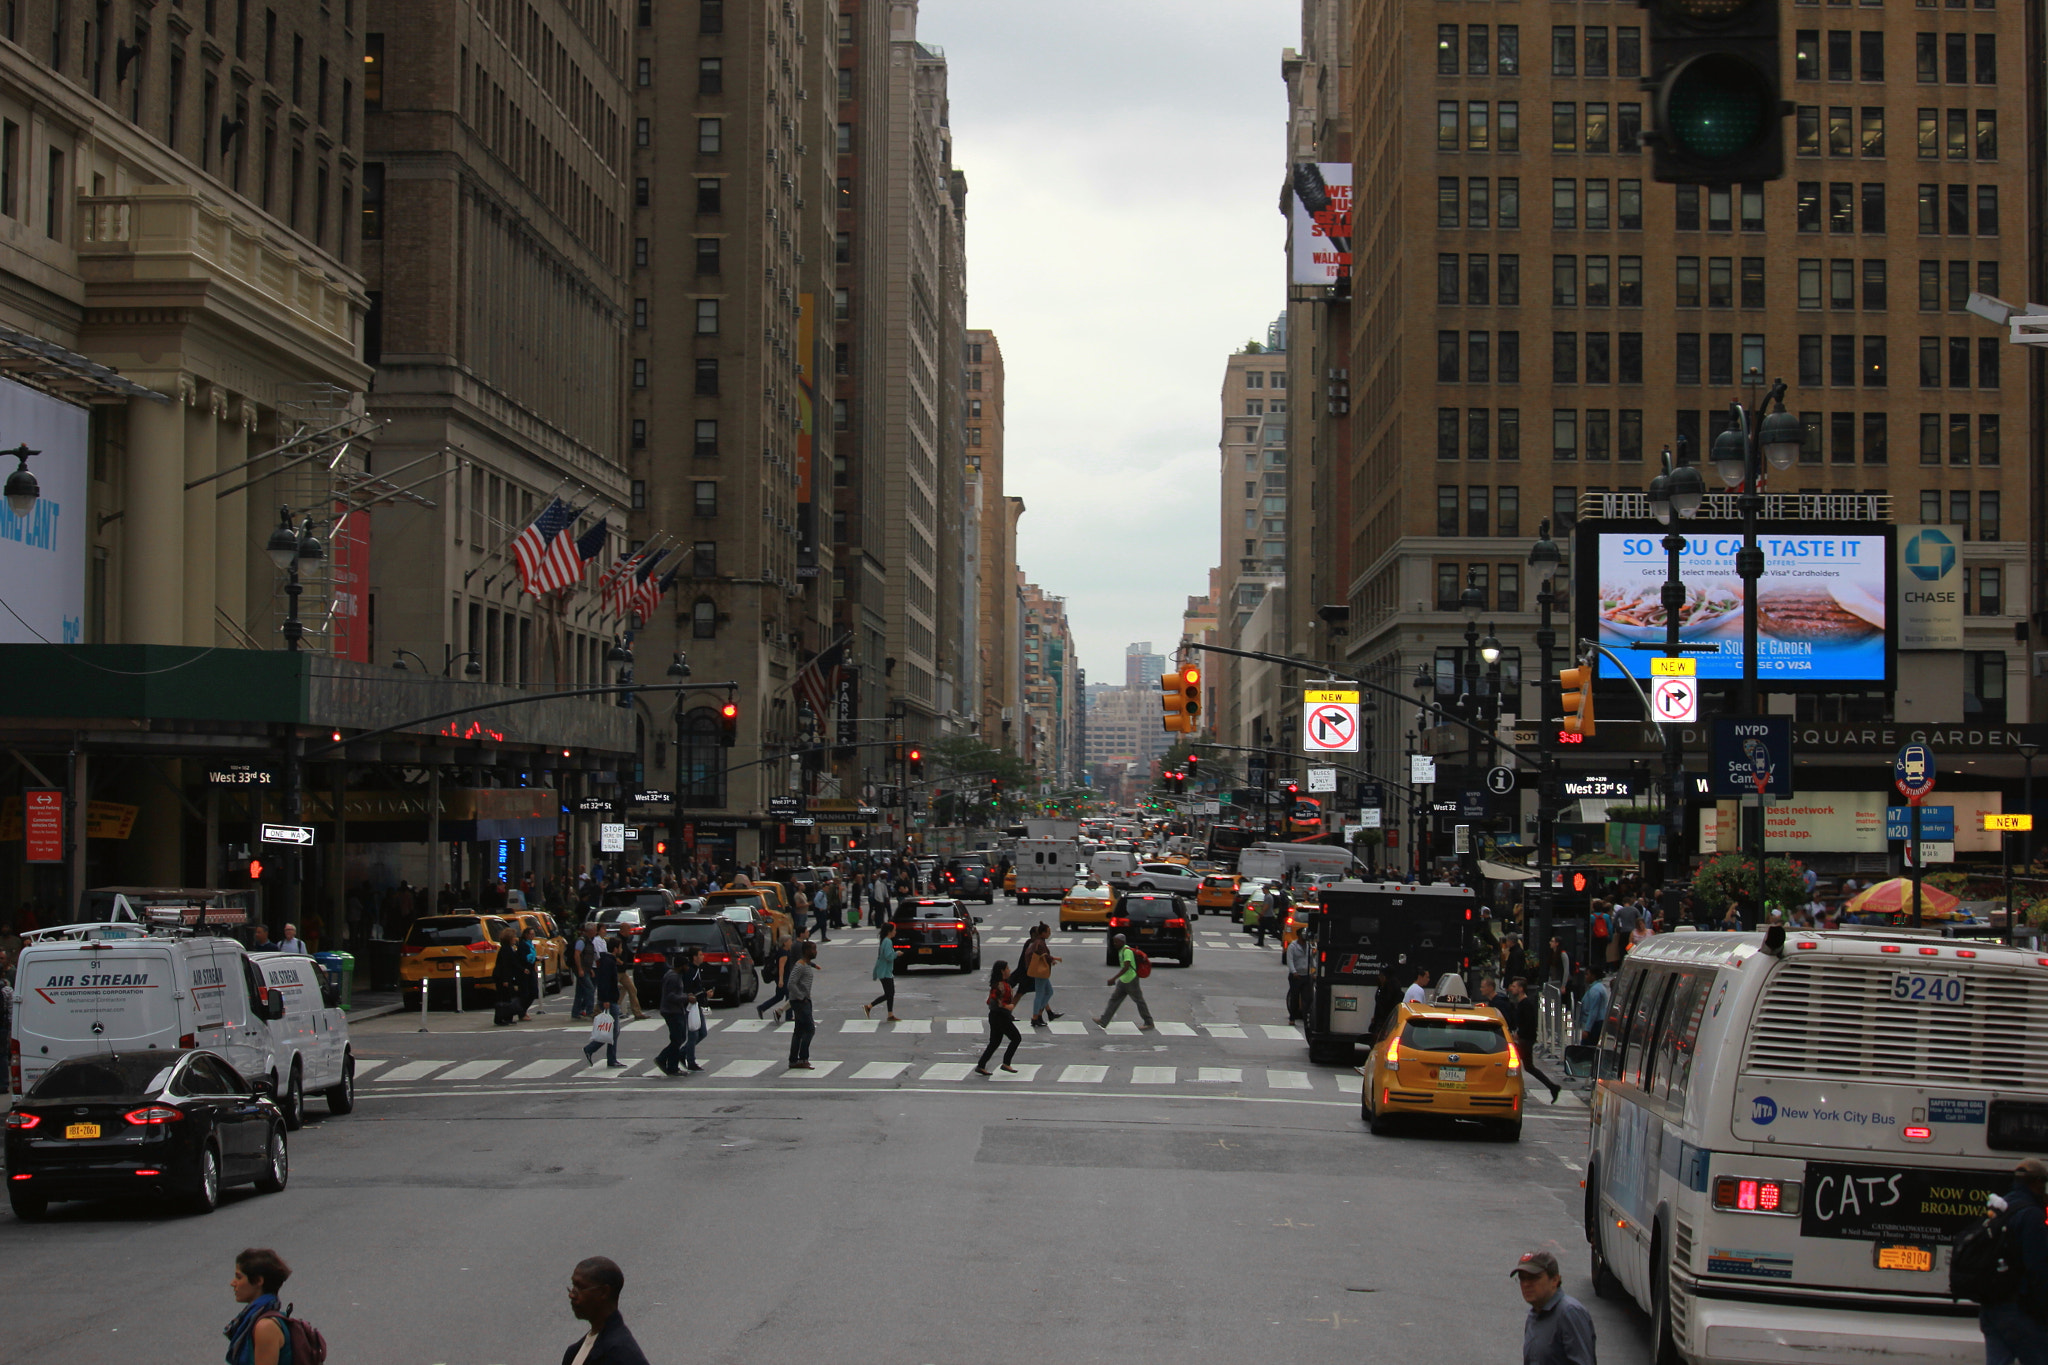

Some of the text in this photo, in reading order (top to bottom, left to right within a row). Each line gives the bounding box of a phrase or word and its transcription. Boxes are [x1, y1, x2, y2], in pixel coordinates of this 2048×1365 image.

[1799, 495, 1877, 521] GARDEN
[1623, 539, 1653, 556] SO
[1768, 540, 1834, 557] TASTE
[1842, 541, 1861, 557] IT
[1905, 592, 1955, 602] CHASE
[1769, 641, 1812, 655] GARDEN
[1661, 662, 1685, 672] NEW
[1787, 661, 1812, 669] VISA
[840, 682, 849, 722] PARK
[1734, 725, 1768, 736] NYPD
[1911, 731, 2023, 746] GARDEN
[209, 771, 271, 783] West 33rd St
[1565, 783, 1628, 794] West 33rd St
[1898, 780, 1931, 796] NO STANDING
[604, 802, 612, 810] St
[1767, 806, 1834, 815] best network
[1767, 817, 1796, 825] made
[1888, 809, 1902, 821] M7
[1997, 818, 2018, 827] NEW
[270, 829, 305, 840] ONE WAY
[1764, 829, 1811, 839] best app.
[1888, 825, 1908, 838] M20
[1934, 825, 1945, 833] Ferry
[91, 961, 101, 969] 91
[46, 974, 149, 987] AIR STREAM
[1893, 975, 1961, 1002] 5240
[1751, 1102, 1773, 1119] MTA
[1781, 1107, 1895, 1125] New York City Bus
[1815, 1172, 1904, 1221] CATS
[1931, 1187, 1991, 1202] NOW ON
[1921, 1202, 1989, 1217] BROADWA
[1906, 1252, 1927, 1265] 8104
